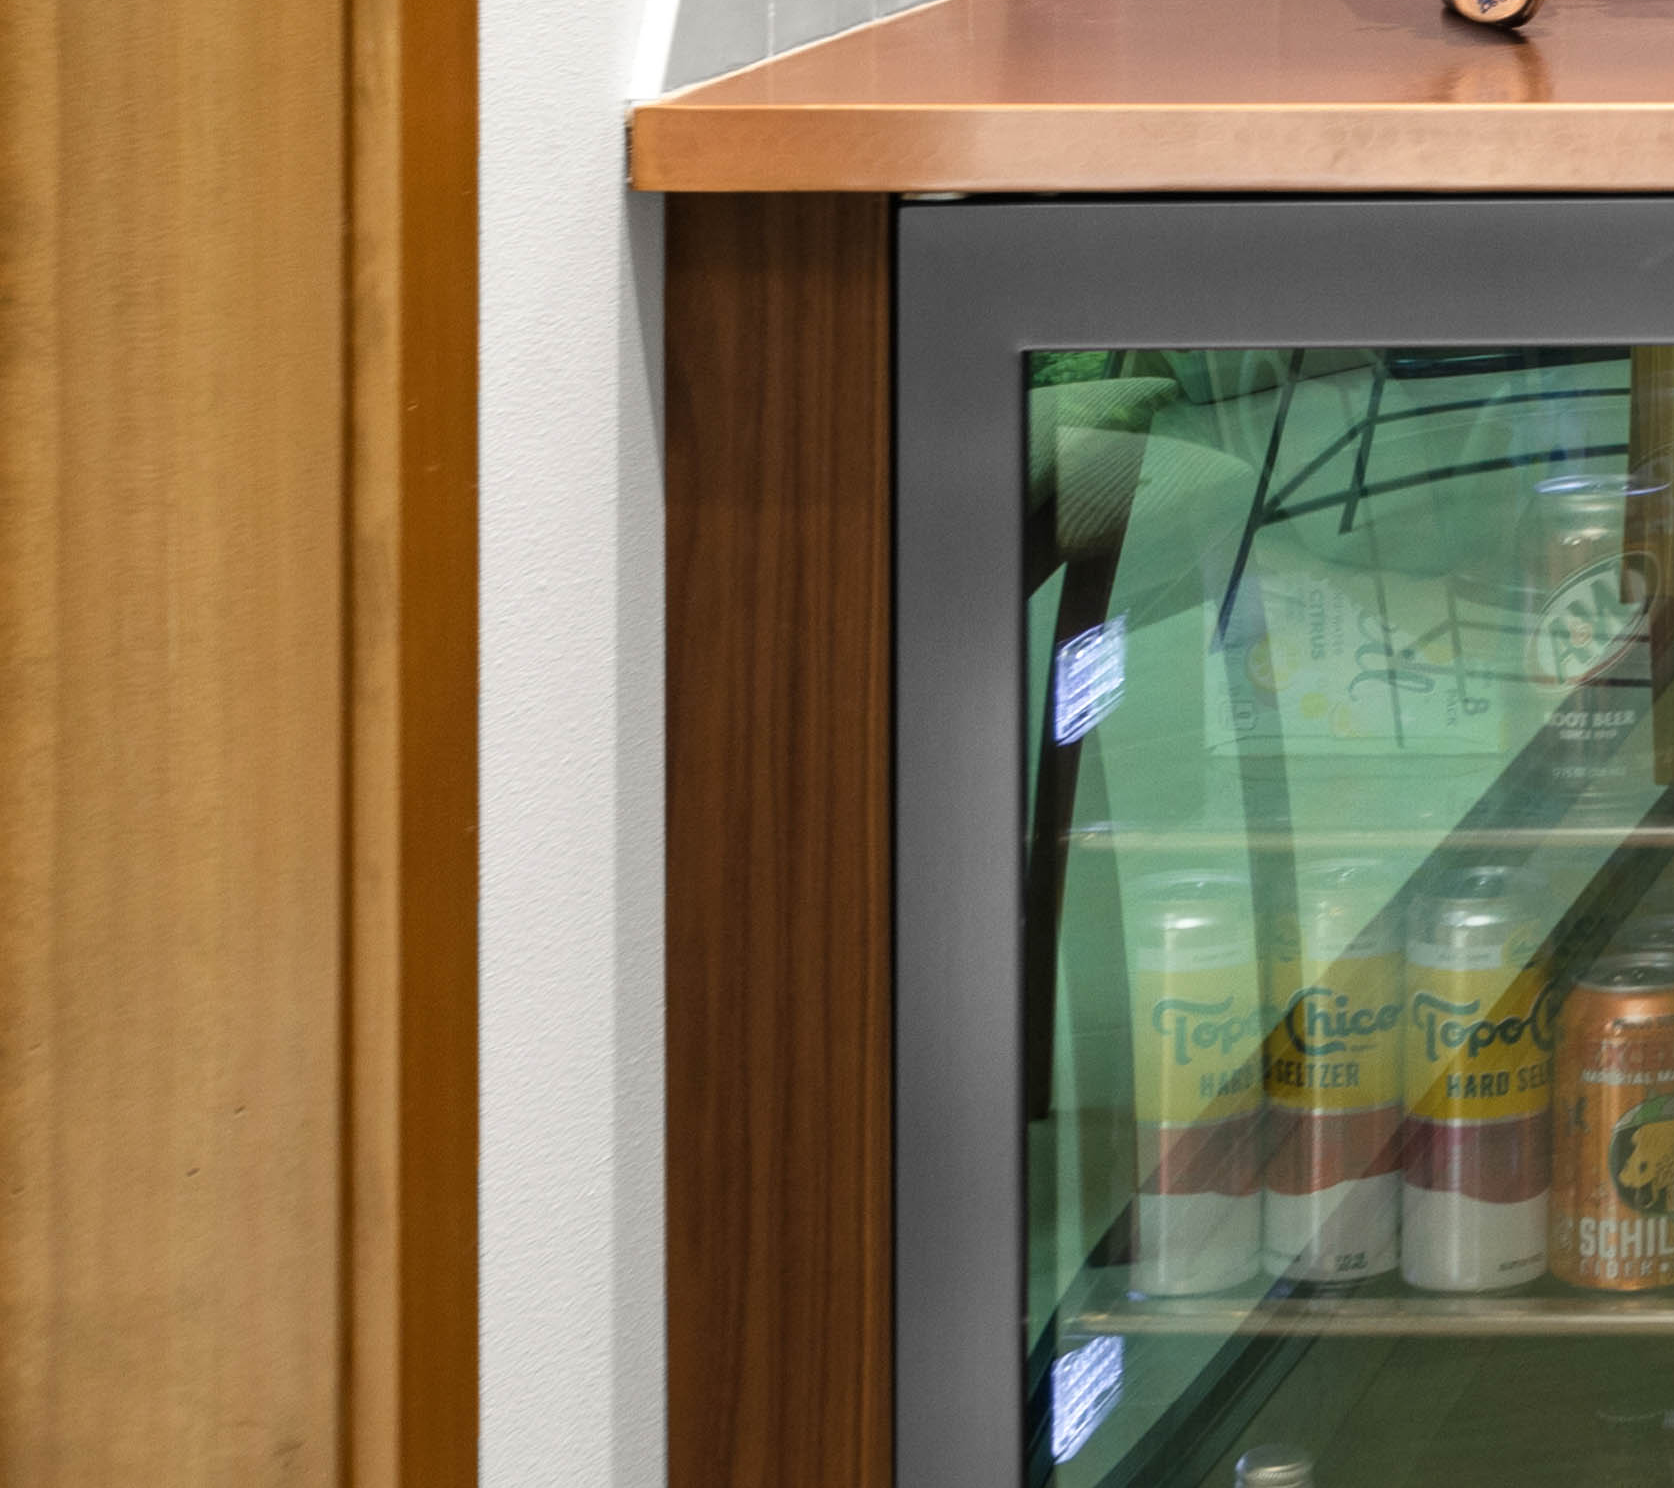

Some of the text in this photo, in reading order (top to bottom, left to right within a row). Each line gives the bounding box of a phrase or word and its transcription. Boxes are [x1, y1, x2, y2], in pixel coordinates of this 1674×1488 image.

[1285, 985, 1403, 1057] Chico
[1412, 991, 1526, 1063] Topo
[1274, 1059, 1361, 1090] SELTZER
[1446, 1071, 1511, 1098] HARD
